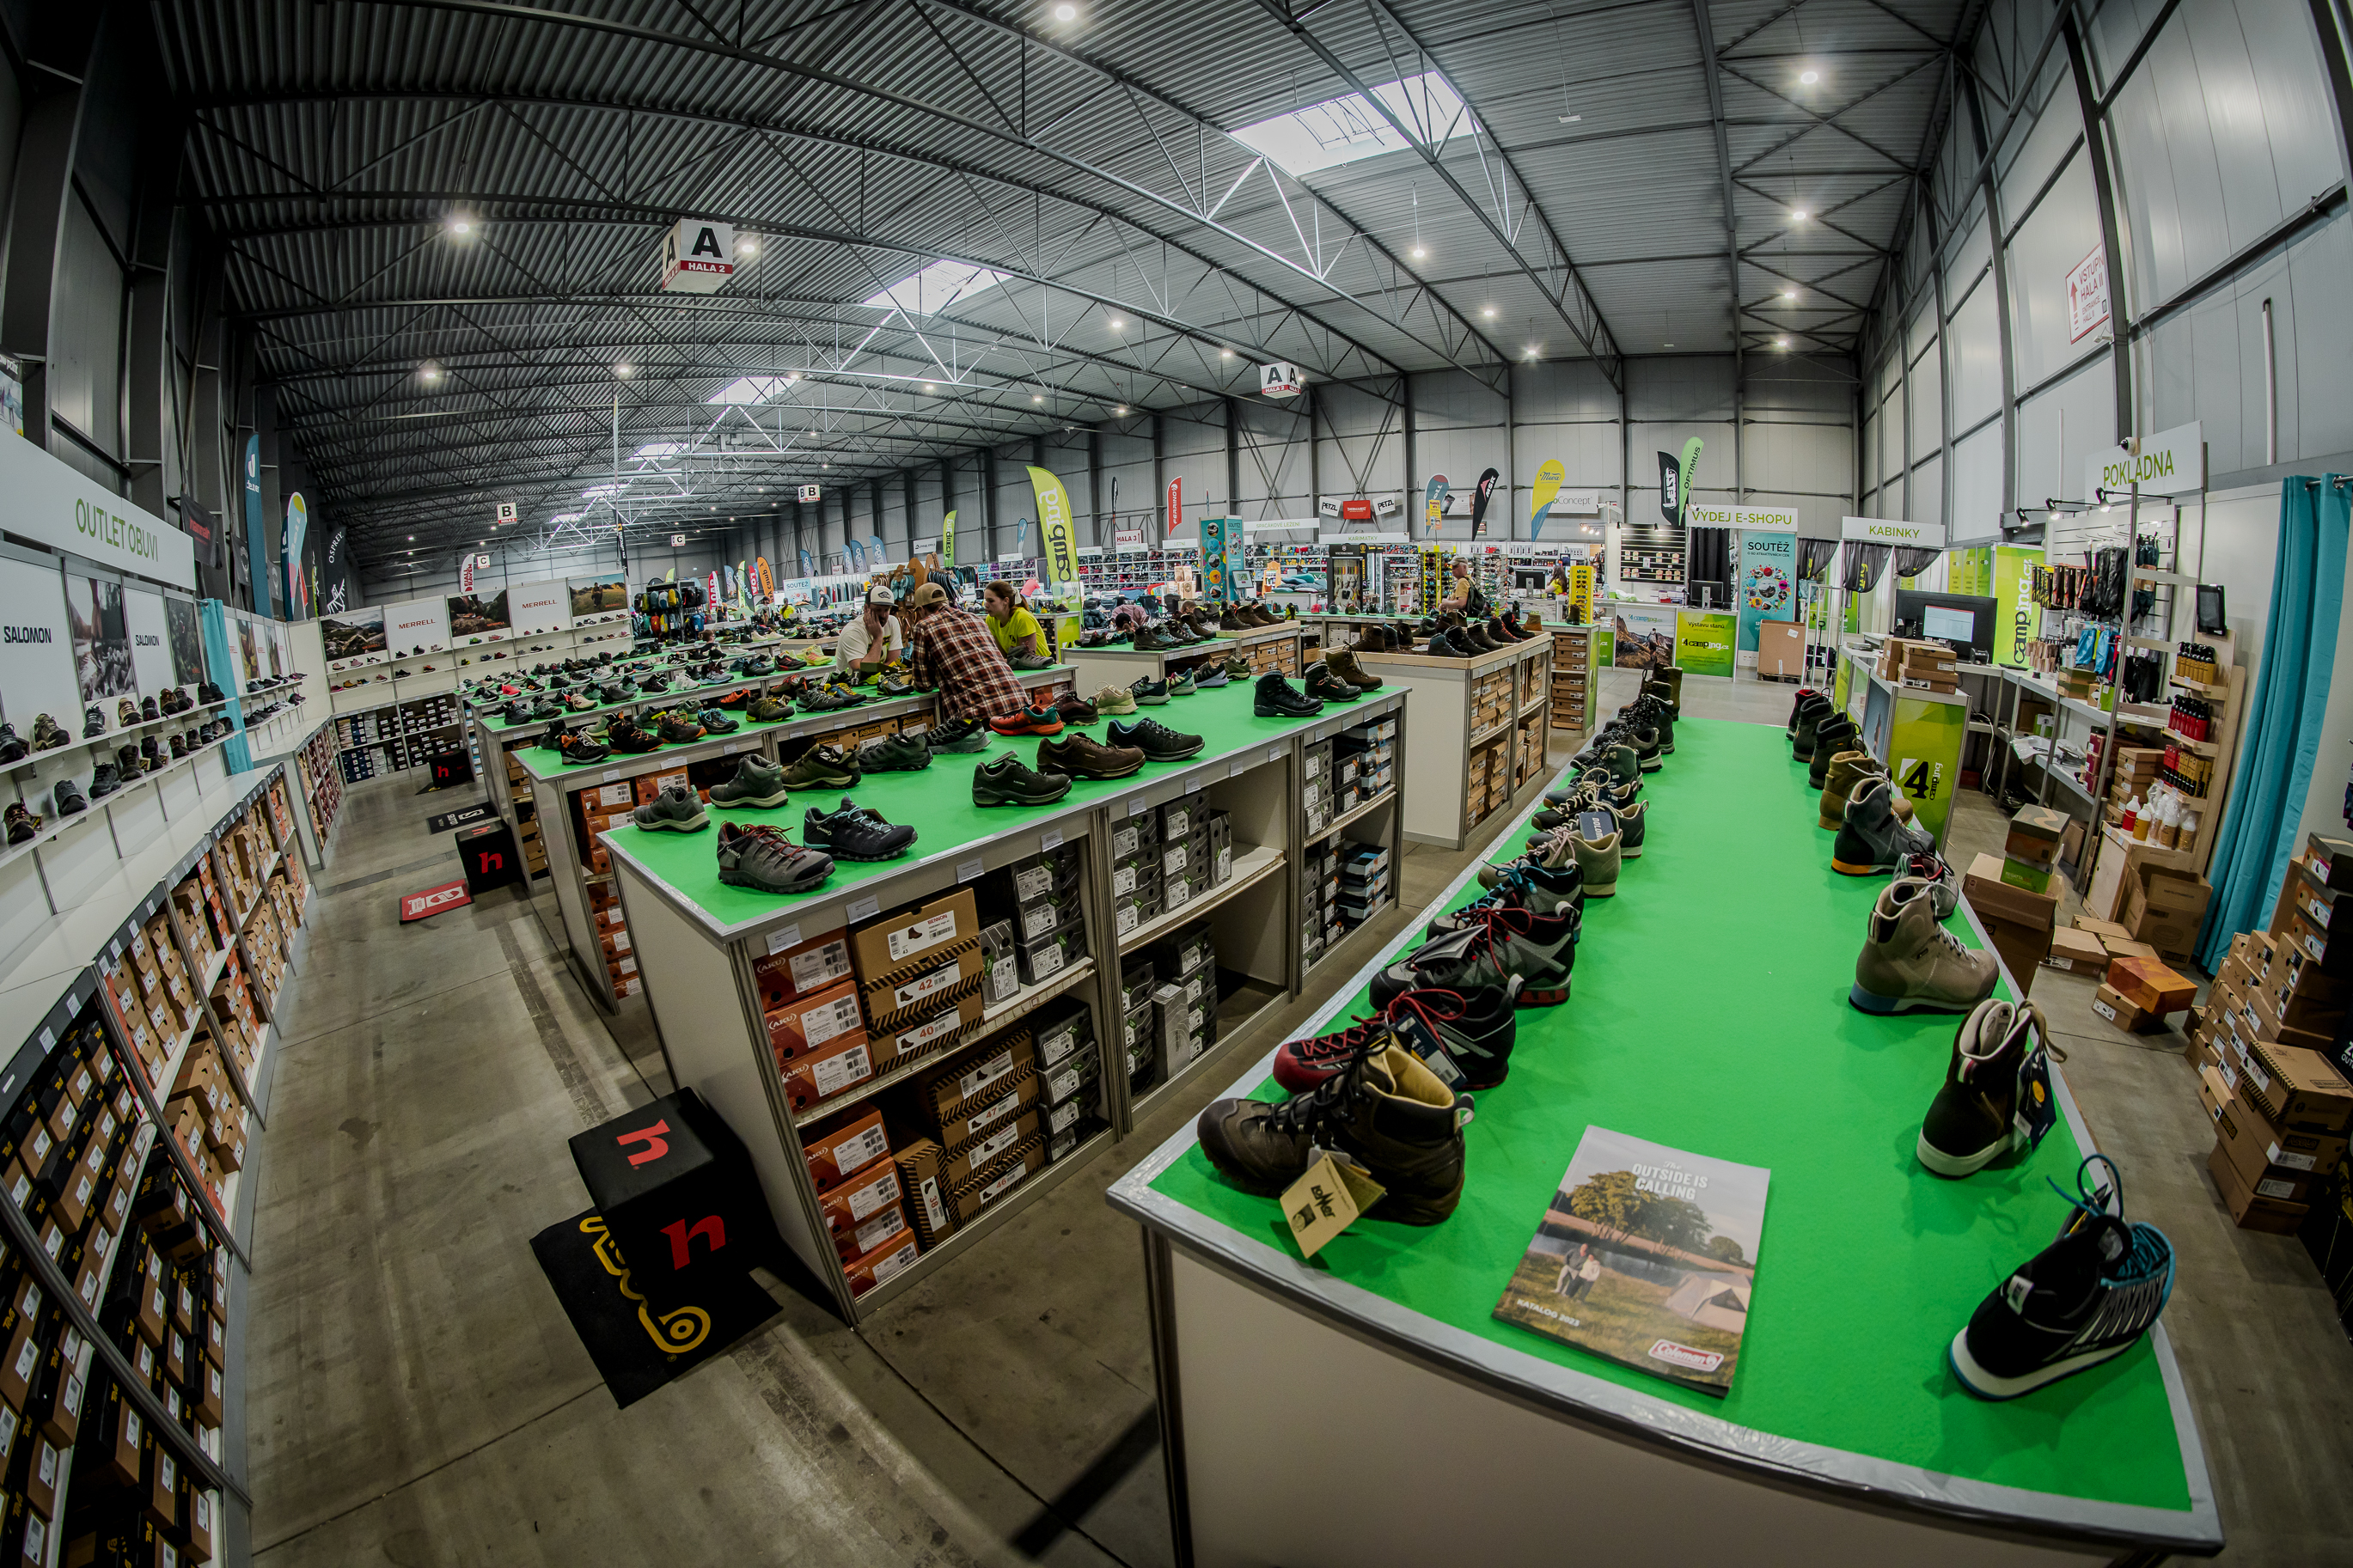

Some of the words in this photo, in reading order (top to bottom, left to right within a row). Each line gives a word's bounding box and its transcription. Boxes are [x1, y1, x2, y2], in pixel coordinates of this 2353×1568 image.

[691, 227, 724, 258] A
[666, 234, 676, 271] A
[688, 262, 717, 272] HALA
[718, 265, 725, 273] 2
[2079, 252, 2105, 284] VSTUPN
[2080, 278, 2099, 302] HALA
[2081, 296, 2100, 315] ENTRANCE
[2083, 313, 2092, 324] HALL
[1267, 367, 1282, 385] A
[1290, 368, 1298, 385] A
[1684, 447, 1700, 489] OPTIMUS
[2103, 449, 2174, 488] POKLADNA
[809, 487, 816, 497] B
[1485, 475, 1495, 498] MSR
[502, 505, 512, 517] B
[1322, 502, 1338, 512] PETZL
[1378, 500, 1394, 512] PETZL
[1692, 509, 1731, 522] VÝDEJ
[1736, 513, 1793, 525] E-SHOPU
[76, 498, 125, 550] OUTLET
[128, 524, 159, 562] OBUVI
[1868, 526, 1920, 539] KABINKY
[328, 531, 344, 564] OSPREY
[1748, 541, 1789, 552] SOUTĚŽ
[749, 572, 758, 595] LOA
[522, 600, 557, 609] MERRELL
[398, 619, 437, 630] MERRELL
[3, 625, 52, 644] SALOMON
[136, 635, 160, 646] SALOMON
[859, 727, 880, 737] ASOLO
[1904, 761, 1929, 799] 4
[927, 914, 947, 924] BENNON
[894, 976, 914, 987] BENNON
[918, 978, 933, 991] 42
[772, 1014, 794, 1028] AKU
[920, 1026, 934, 1038] 40
[2251, 1065, 2258, 1076] 41
[987, 1107, 997, 1119] 47
[1662, 1160, 1683, 1171] The
[1633, 1163, 1691, 1186] OUTSIDE
[1694, 1175, 1708, 1189] IS
[997, 1178, 1007, 1189] 46
[1635, 1178, 1696, 1201] CALLING
[930, 1195, 938, 1209] 38
[1516, 1297, 1557, 1320] KATALOG
[1559, 1314, 1580, 1327] 2023
[1655, 1342, 1707, 1364] Coleman
